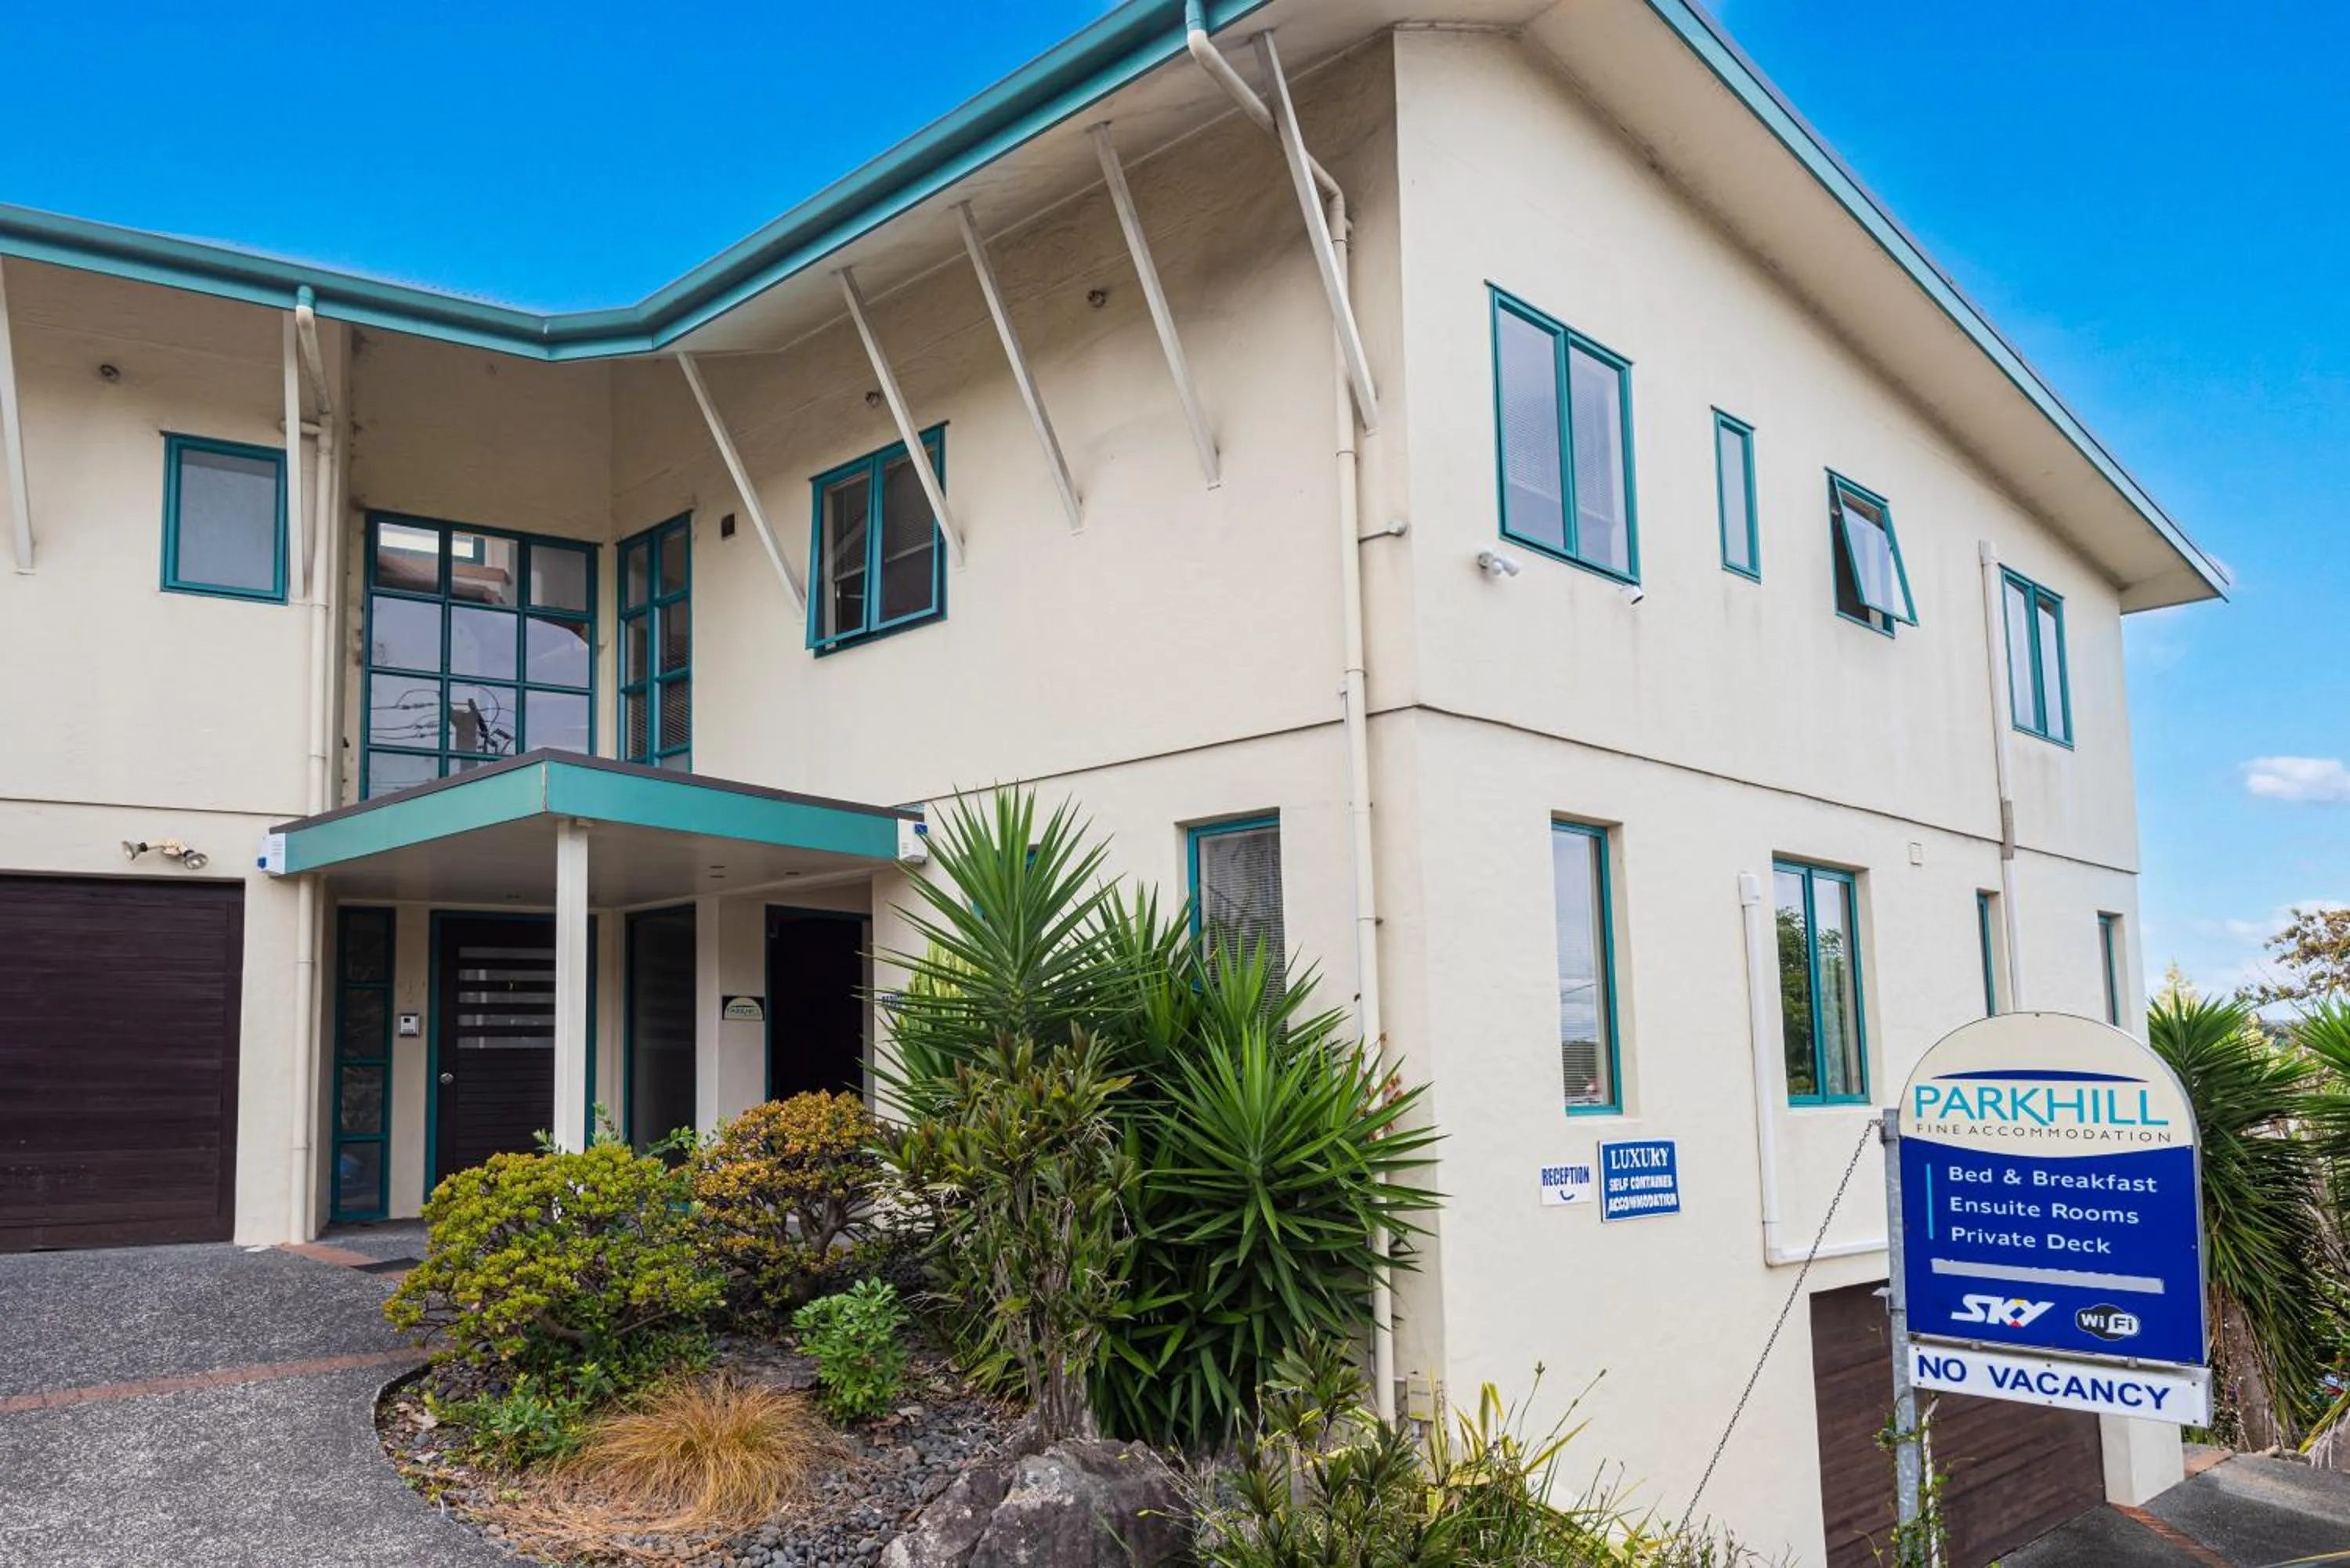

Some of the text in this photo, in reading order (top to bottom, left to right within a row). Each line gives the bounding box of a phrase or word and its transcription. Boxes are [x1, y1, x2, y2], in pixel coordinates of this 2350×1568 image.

[1914, 1085, 2169, 1126] PARKHILL
[1916, 1123, 2171, 1143] FINE ACCOMMODATION
[1611, 1147, 1668, 1169] LUXURY
[1542, 1165, 1589, 1186] RECEPTION
[1609, 1177, 1629, 1192] SELF
[1948, 1165, 2158, 1194] Bed & Breakfast
[1608, 1193, 1677, 1212] ACCOMMODATION
[1949, 1196, 2140, 1225] Ensuite Rooms
[1950, 1226, 2112, 1254] Private Deck
[1950, 1293, 2056, 1328] SKY
[1918, 1354, 2171, 1410] NO VACANCY
